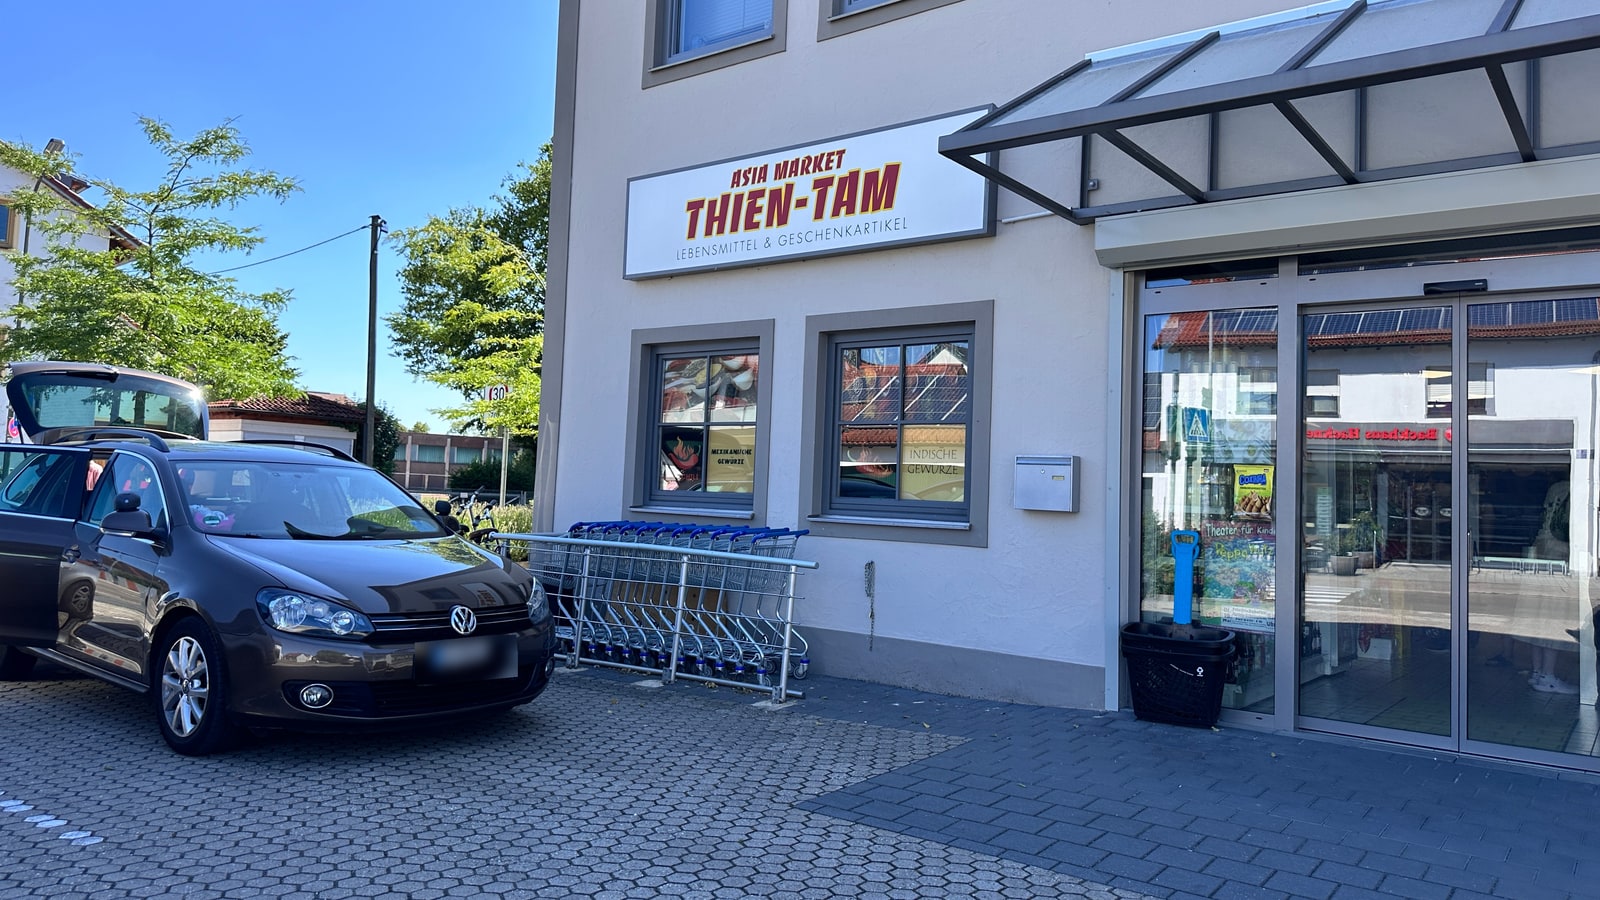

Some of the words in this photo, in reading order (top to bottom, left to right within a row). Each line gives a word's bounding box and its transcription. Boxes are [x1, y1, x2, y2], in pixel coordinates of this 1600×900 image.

[731, 163, 768, 189] ASIA
[773, 149, 846, 181] MARKET
[685, 162, 902, 240] THIEN-TAM
[676, 239, 758, 261] LEBENSMITTEL
[764, 237, 772, 249] &
[778, 217, 908, 247] GESCHENKARTIKEL
[492, 386, 505, 401] 30
[910, 449, 957, 460] INDISCHE
[1206, 523, 1238, 537] Theater
[1241, 524, 1253, 534] für
